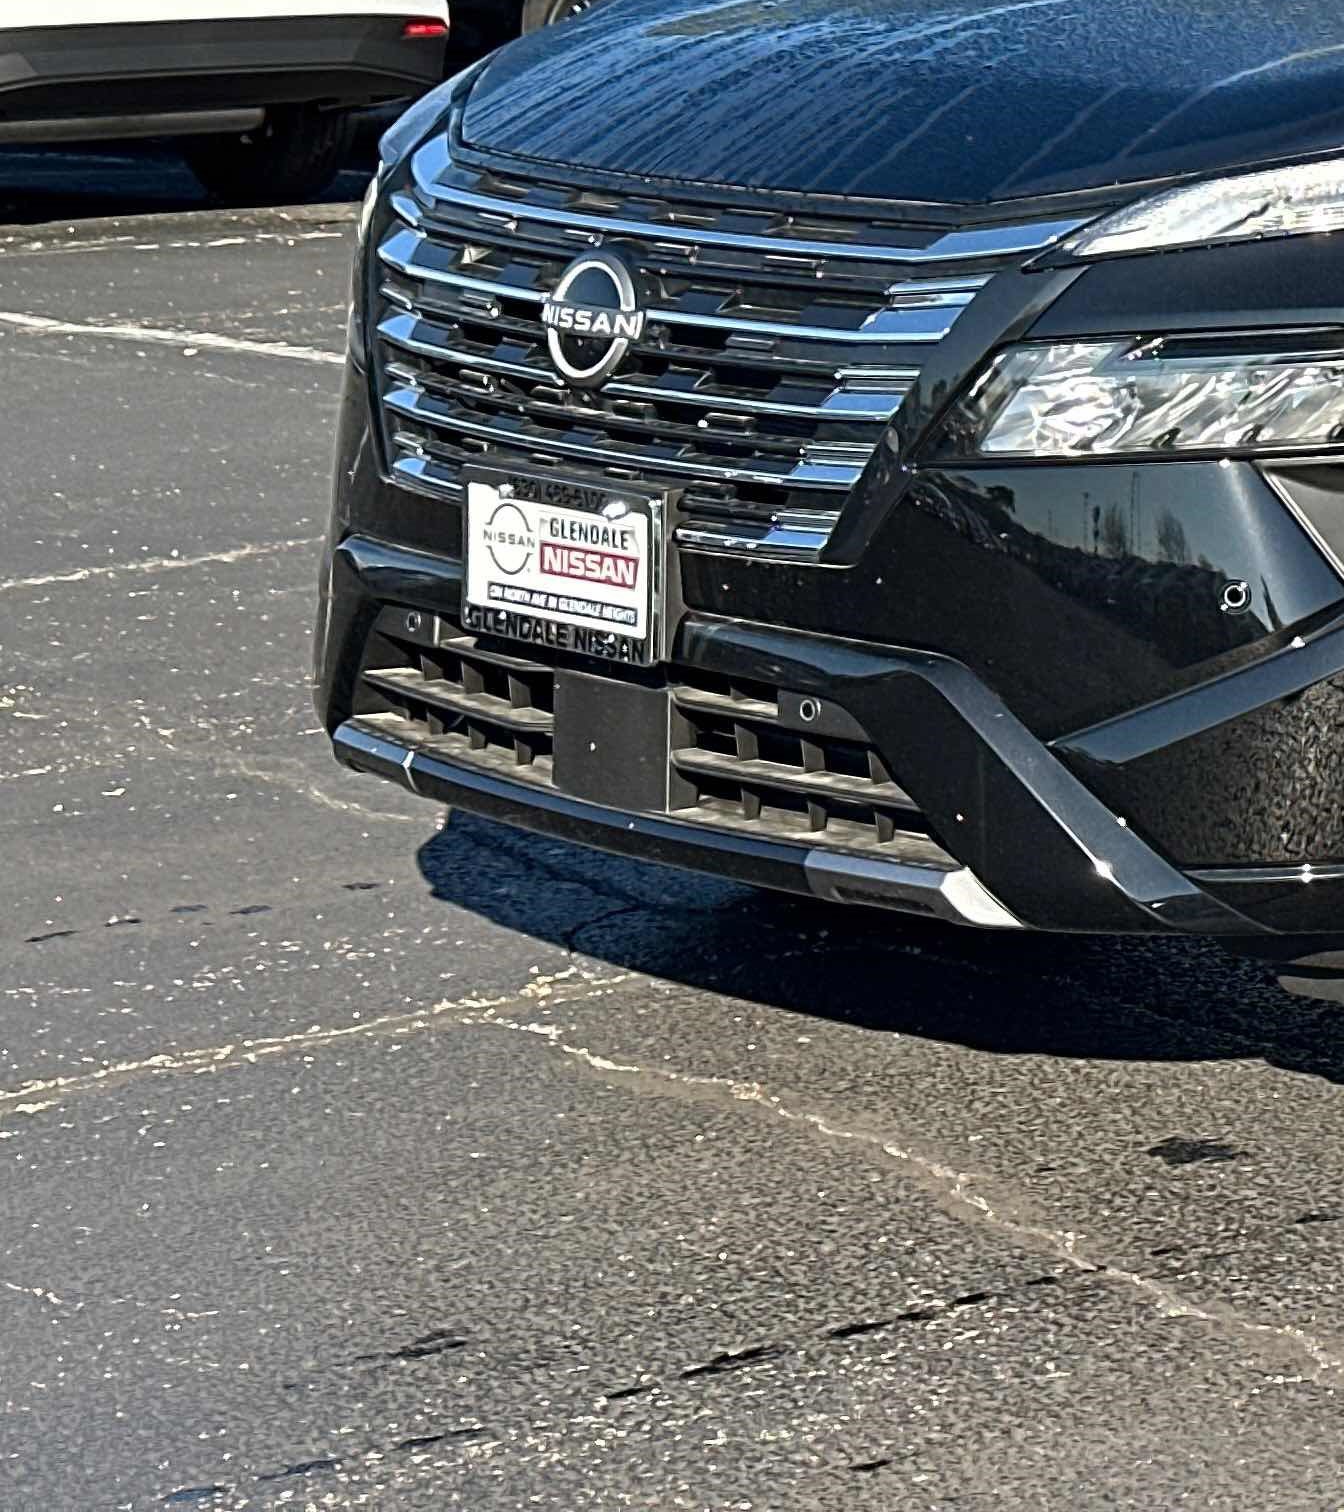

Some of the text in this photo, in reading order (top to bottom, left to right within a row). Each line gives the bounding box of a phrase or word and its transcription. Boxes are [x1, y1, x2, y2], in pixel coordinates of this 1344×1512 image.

[542, 303, 644, 340] NISSAN
[483, 528, 535, 548] NISSAN
[550, 518, 630, 550] GLENDALE
[543, 546, 636, 585] NISSAN
[469, 609, 646, 662] GLENDALE NISSAN
